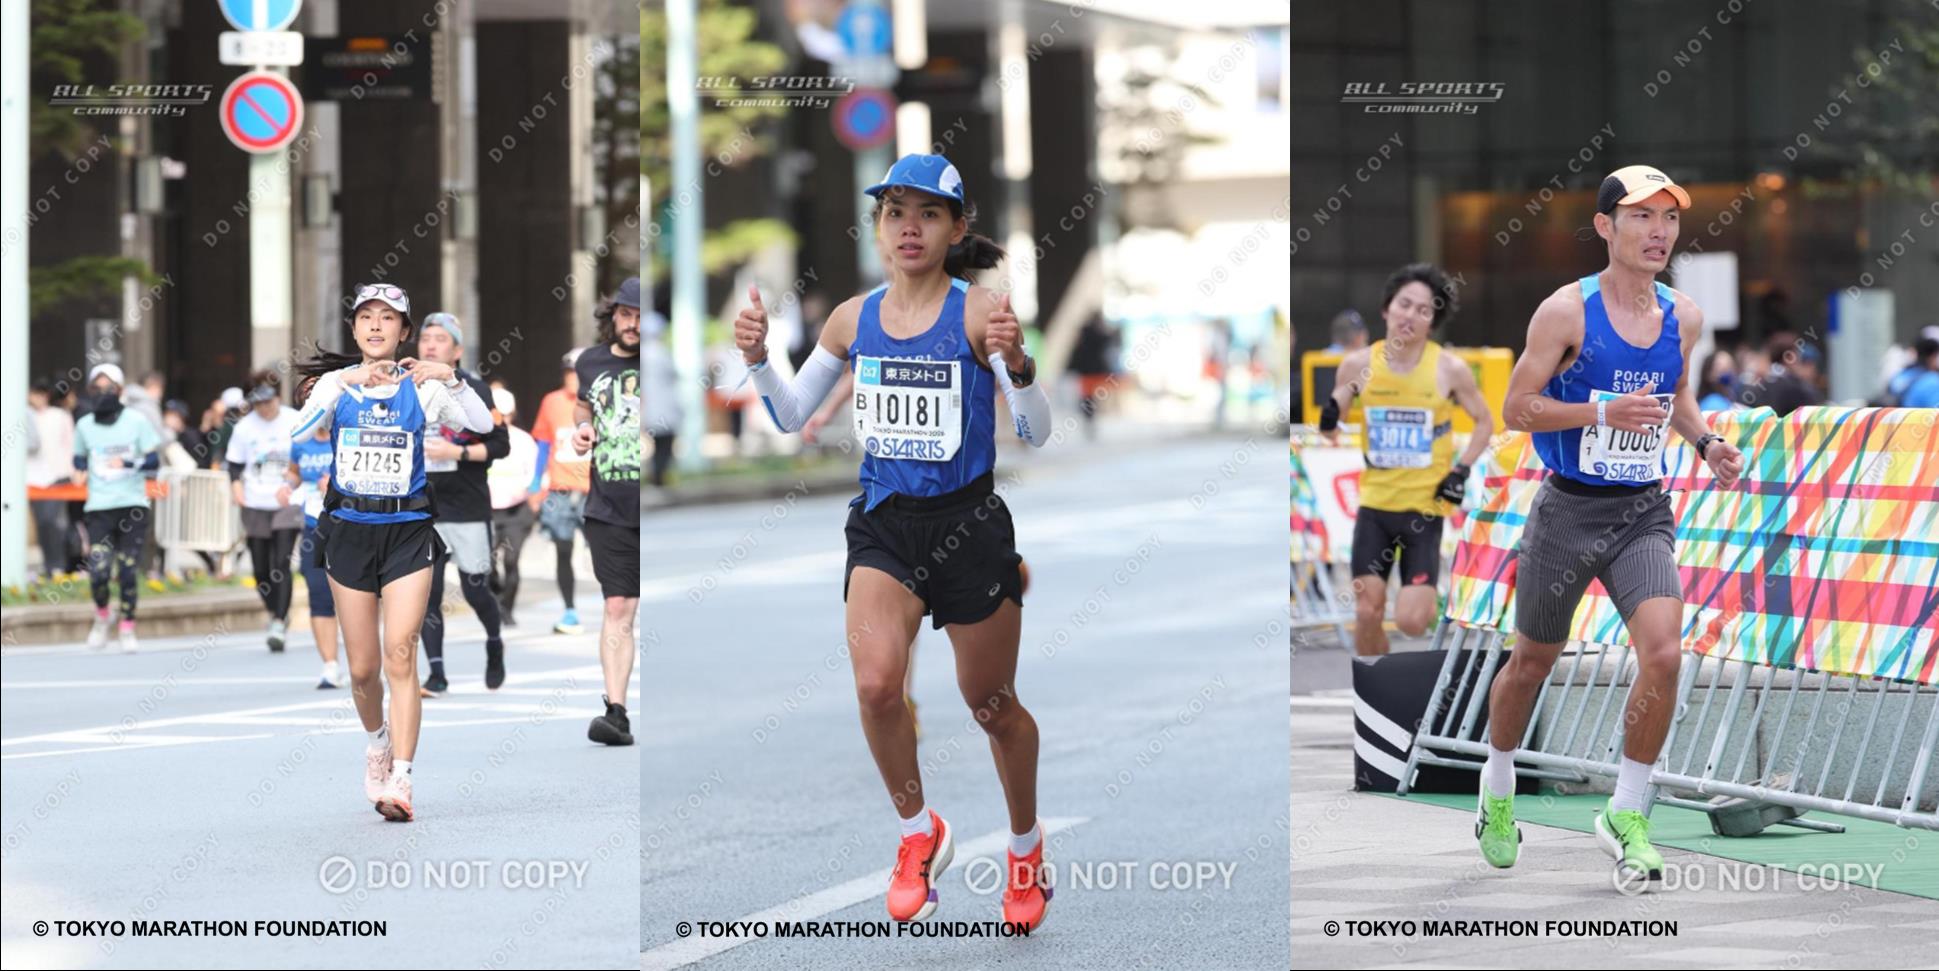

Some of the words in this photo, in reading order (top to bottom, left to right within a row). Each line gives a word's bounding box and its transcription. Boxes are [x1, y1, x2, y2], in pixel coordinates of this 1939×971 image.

[885, 367, 947, 382] 東京メトロ
[1613, 370, 1665, 383] POCARI
[1612, 381, 1660, 394] SWET
[856, 393, 868, 410] B
[876, 393, 940, 428] 10181
[858, 418, 864, 430] 1
[1585, 424, 1599, 439] A
[1378, 427, 1419, 448] 3014
[1586, 447, 1592, 456] 1
[353, 451, 401, 473] 21245
